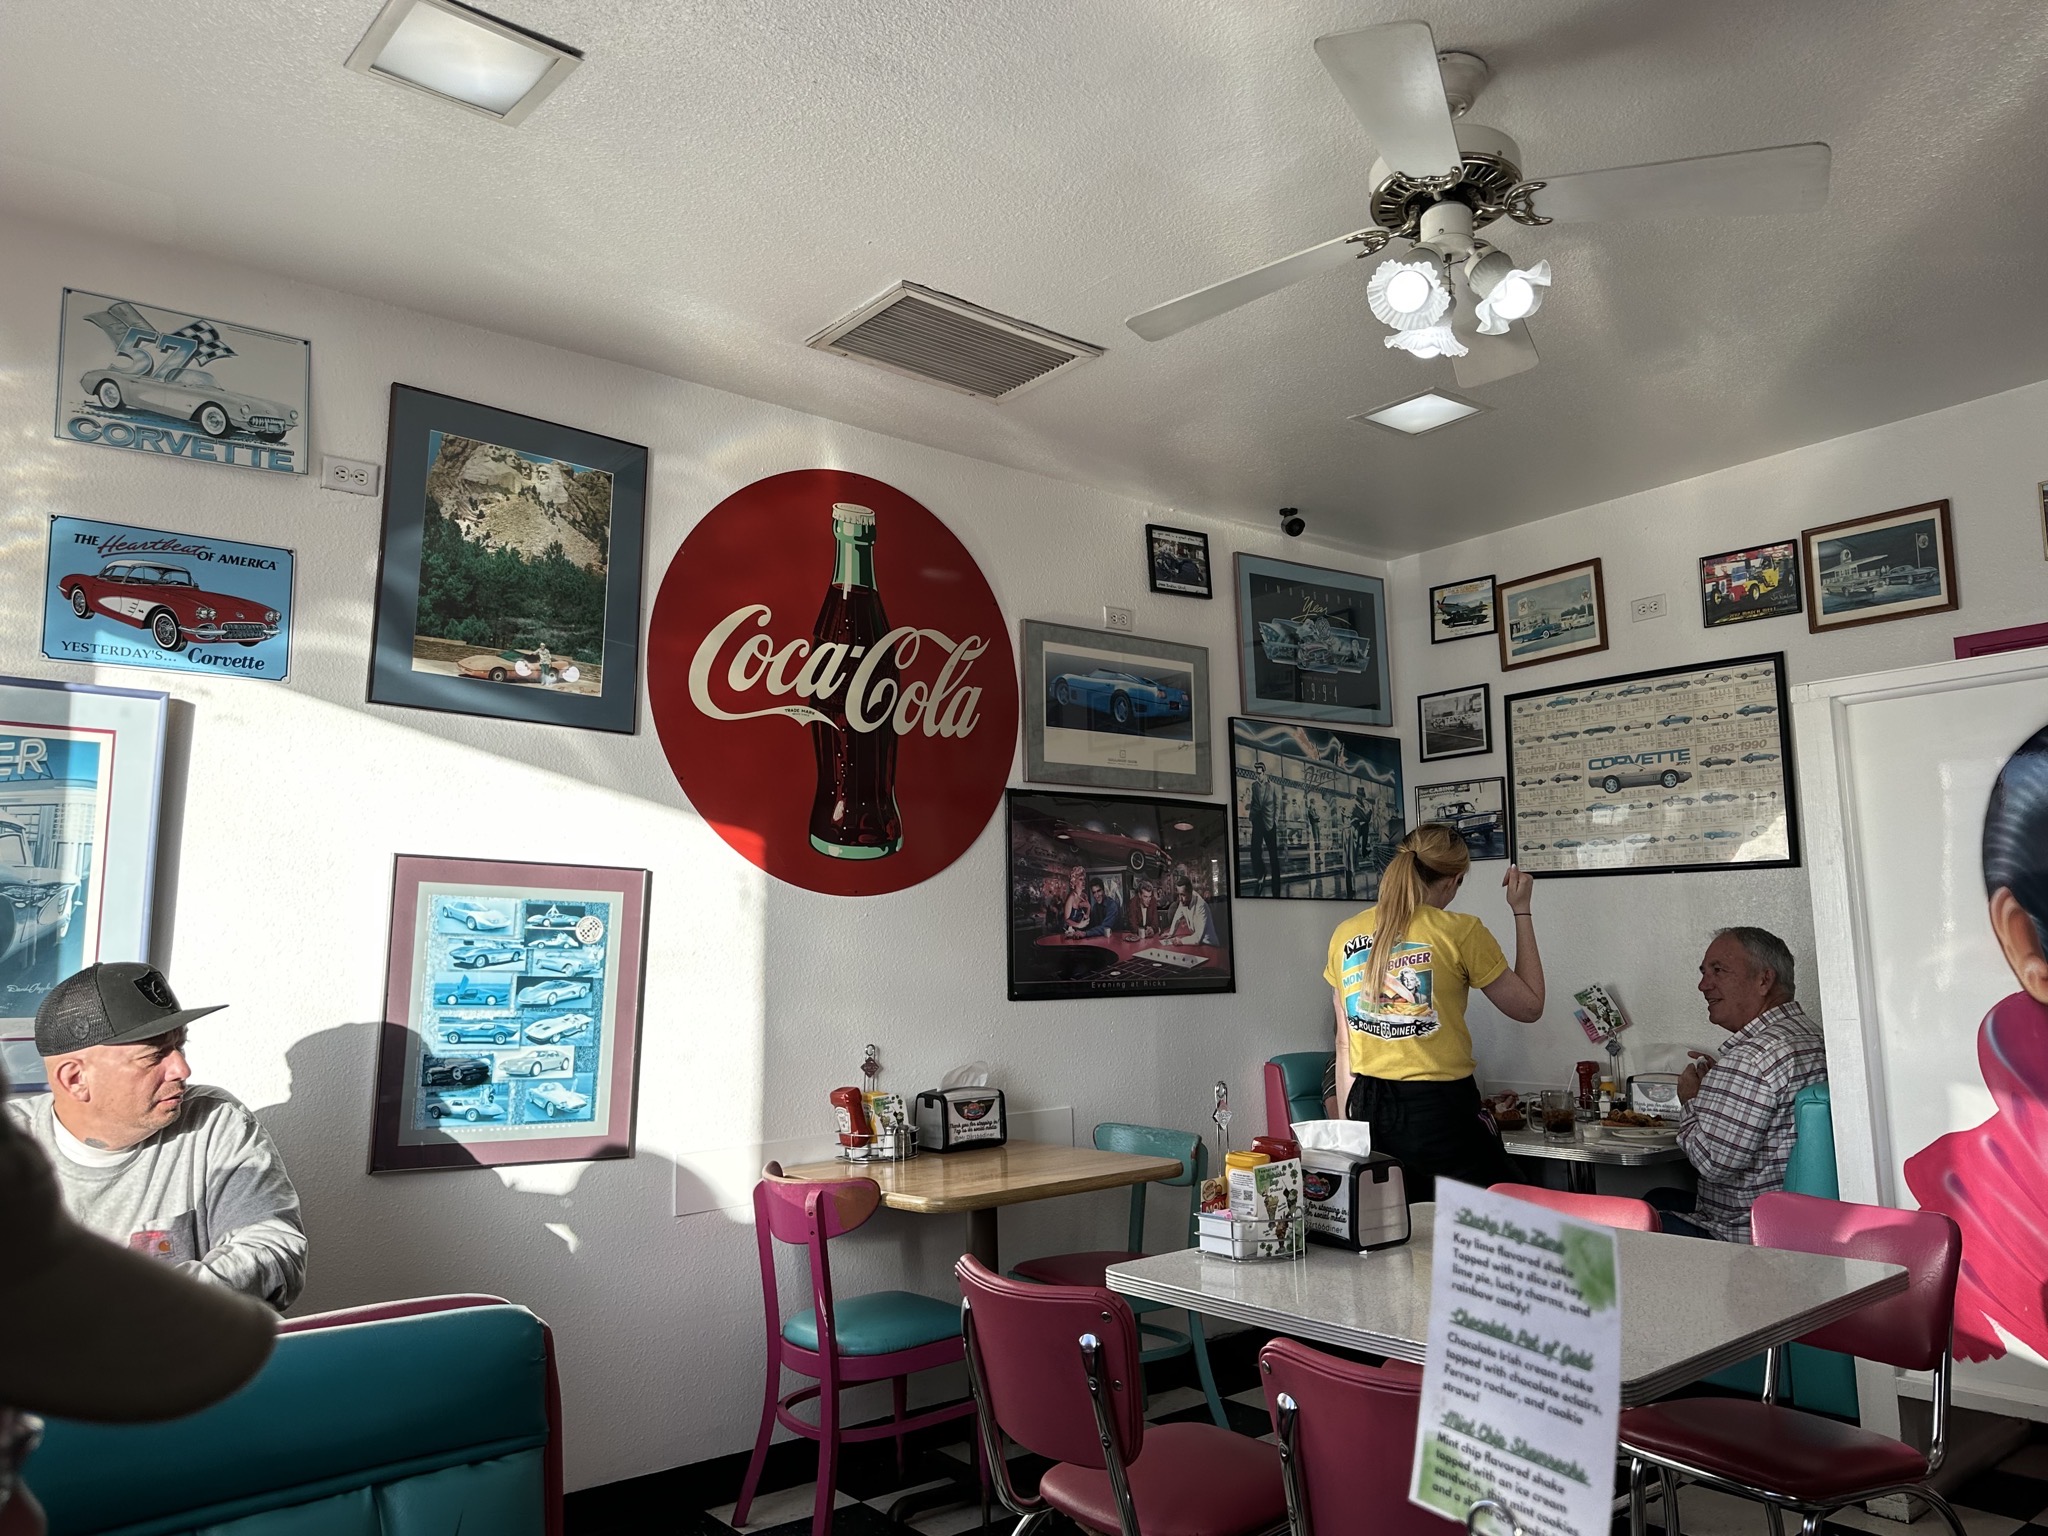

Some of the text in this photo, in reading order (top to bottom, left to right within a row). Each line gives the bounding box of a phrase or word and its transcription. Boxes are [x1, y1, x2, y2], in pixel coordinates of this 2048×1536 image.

[108, 327, 198, 383] 57
[68, 416, 294, 472] CORVETTE
[74, 533, 277, 571] THE Heartbeat OF AMERICA
[188, 647, 265, 670] Corvette
[688, 604, 991, 738] Coca-Cola
[1588, 748, 1691, 770] CORVETTE
[1708, 739, 1767, 754] 1953-1990
[1516, 760, 1581, 775] Technical Data
[1429, 785, 1455, 793] CASINO
[1091, 981, 1126, 989] Evening
[1343, 971, 1363, 988] MON
[1359, 1020, 1380, 1034] ROUTE
[1391, 1025, 1416, 1036] DINER
[1453, 1231, 1575, 1279] Key lime flavored shake
[1453, 1247, 1584, 1300] Topped with a slice of key
[1451, 1281, 1531, 1316] rainbow candy!
[1452, 1262, 1473, 1279] lime
[1495, 1276, 1522, 1297] lucky
[1569, 1302, 1591, 1318] and
[1446, 1349, 1481, 1370] topped
[1484, 1361, 1507, 1379] with
[1509, 1371, 1560, 1398] chocolate
[1447, 1331, 1497, 1358] Chocolate
[1524, 1361, 1558, 1380] cream
[1561, 1372, 1594, 1394] shake
[1524, 1395, 1546, 1411] and
[1548, 1404, 1584, 1426] cookie
[1436, 1449, 1568, 1514] topped with an ice cream
[1437, 1431, 1565, 1495] Mint chip flavored shake
[1432, 1482, 1452, 1498] and
[1434, 1466, 1484, 1496] sandwich,
[1509, 1497, 1535, 1518] mint
